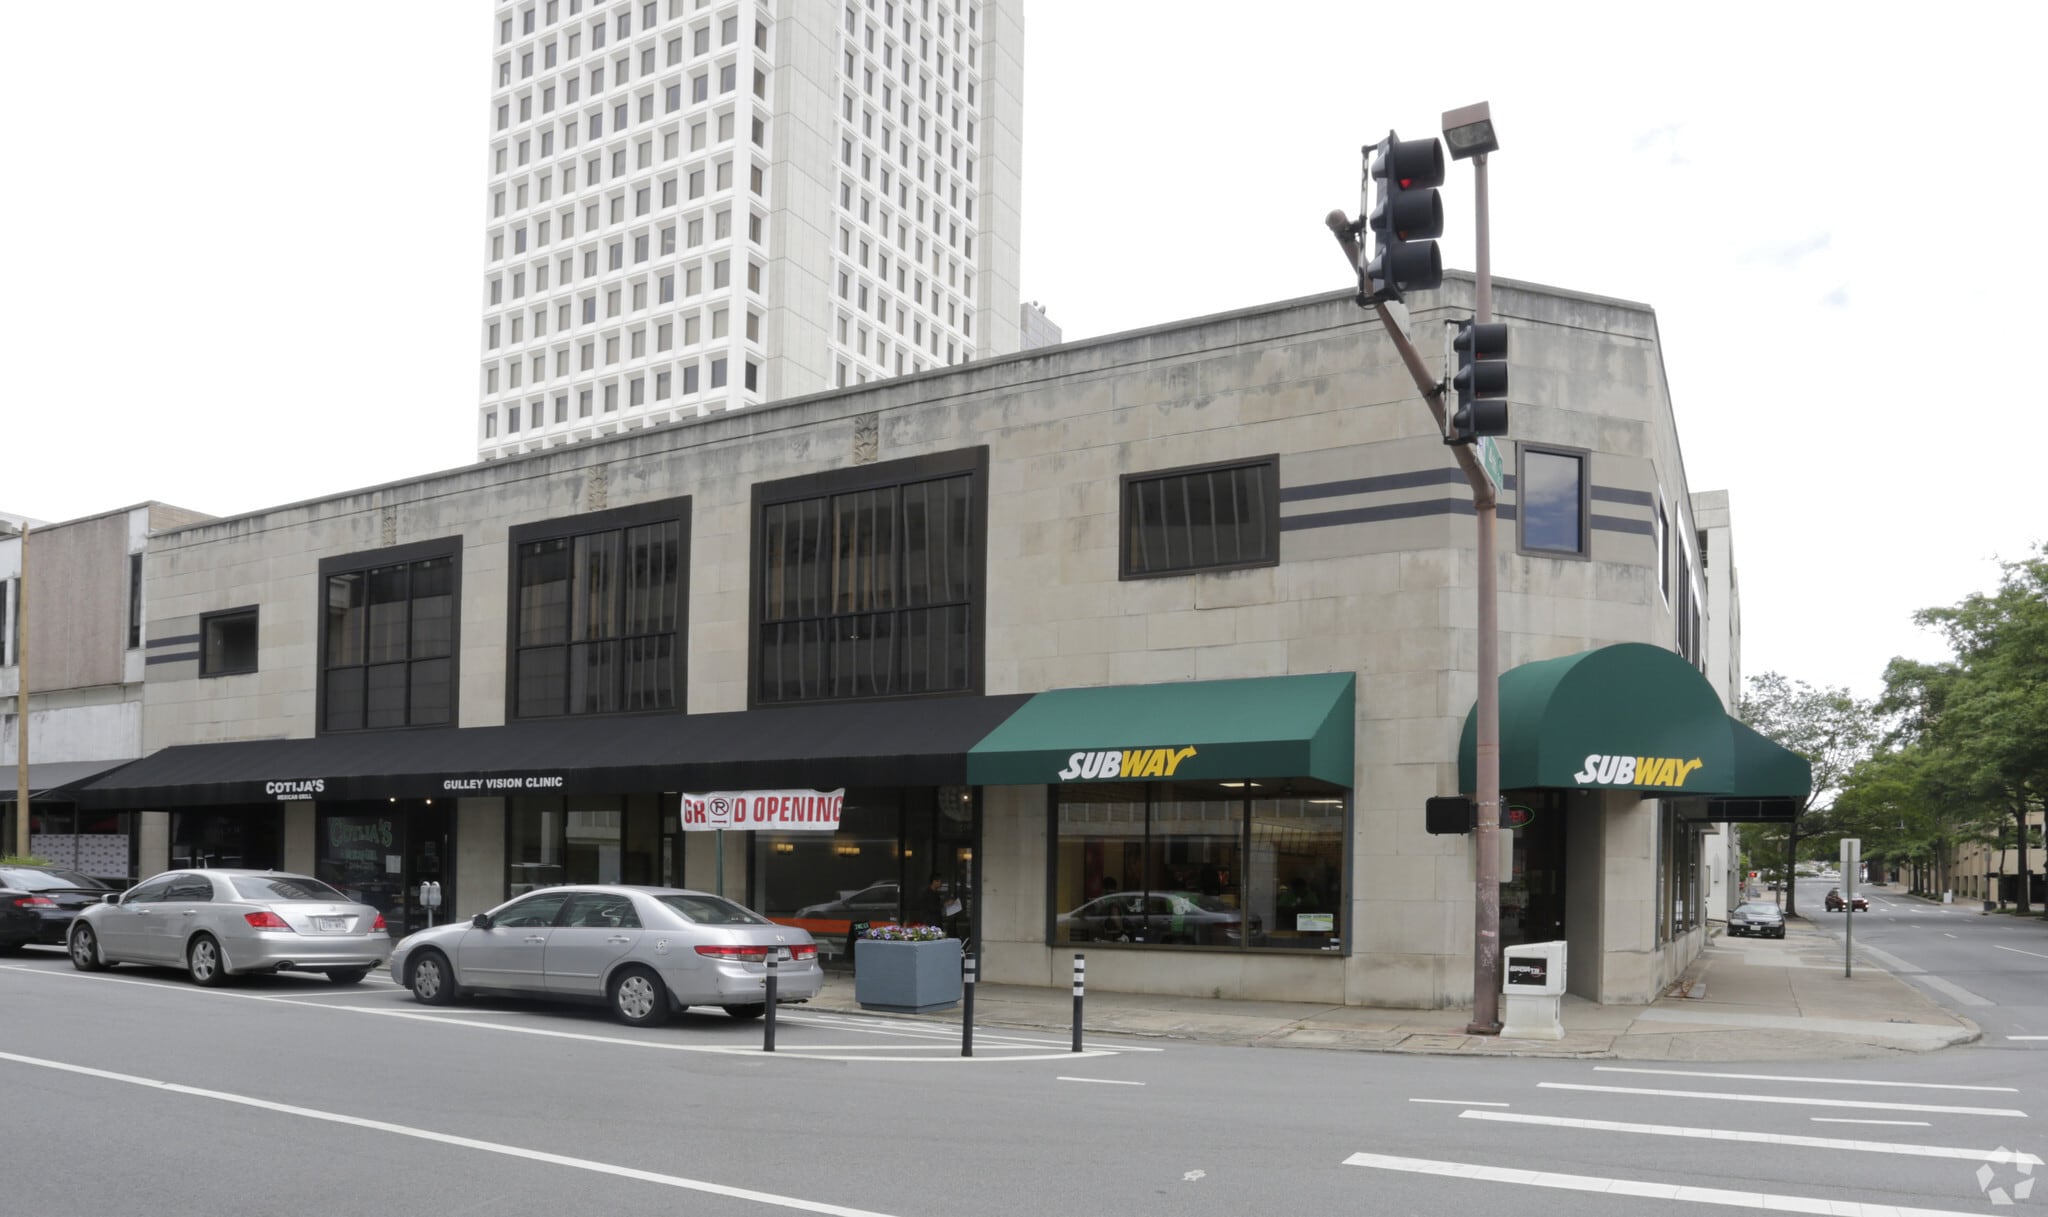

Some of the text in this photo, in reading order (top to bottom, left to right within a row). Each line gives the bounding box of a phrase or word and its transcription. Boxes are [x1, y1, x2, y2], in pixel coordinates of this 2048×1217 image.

[1058, 745, 1197, 781] SUBWAY
[1574, 754, 1703, 787] SUBWAY
[265, 779, 325, 794] COTIJA'S
[443, 776, 563, 790] GULLEY VISION CLINIC
[684, 795, 845, 824] GRD OPENING
